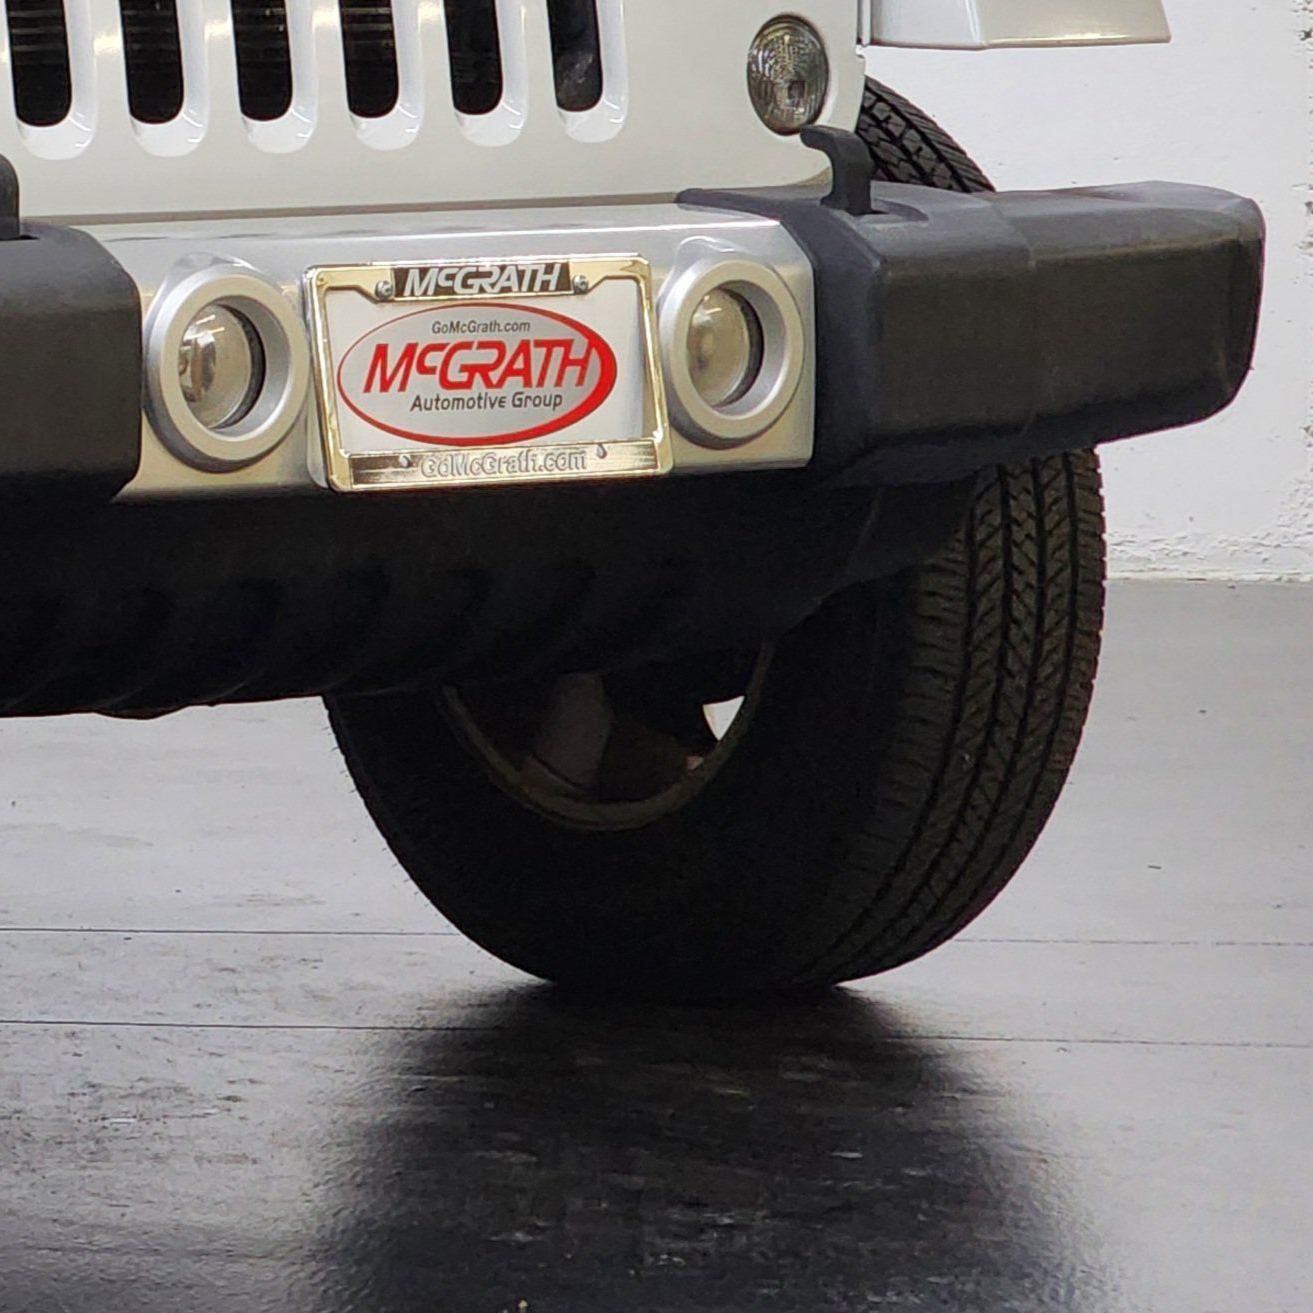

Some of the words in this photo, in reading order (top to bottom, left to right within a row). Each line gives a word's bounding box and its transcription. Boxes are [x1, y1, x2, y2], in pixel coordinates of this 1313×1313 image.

[431, 319, 531, 335] GoMcGrath.com
[410, 392, 507, 412] Automotive
[511, 391, 563, 411] Group
[420, 451, 588, 479] GoMcGrath.com
